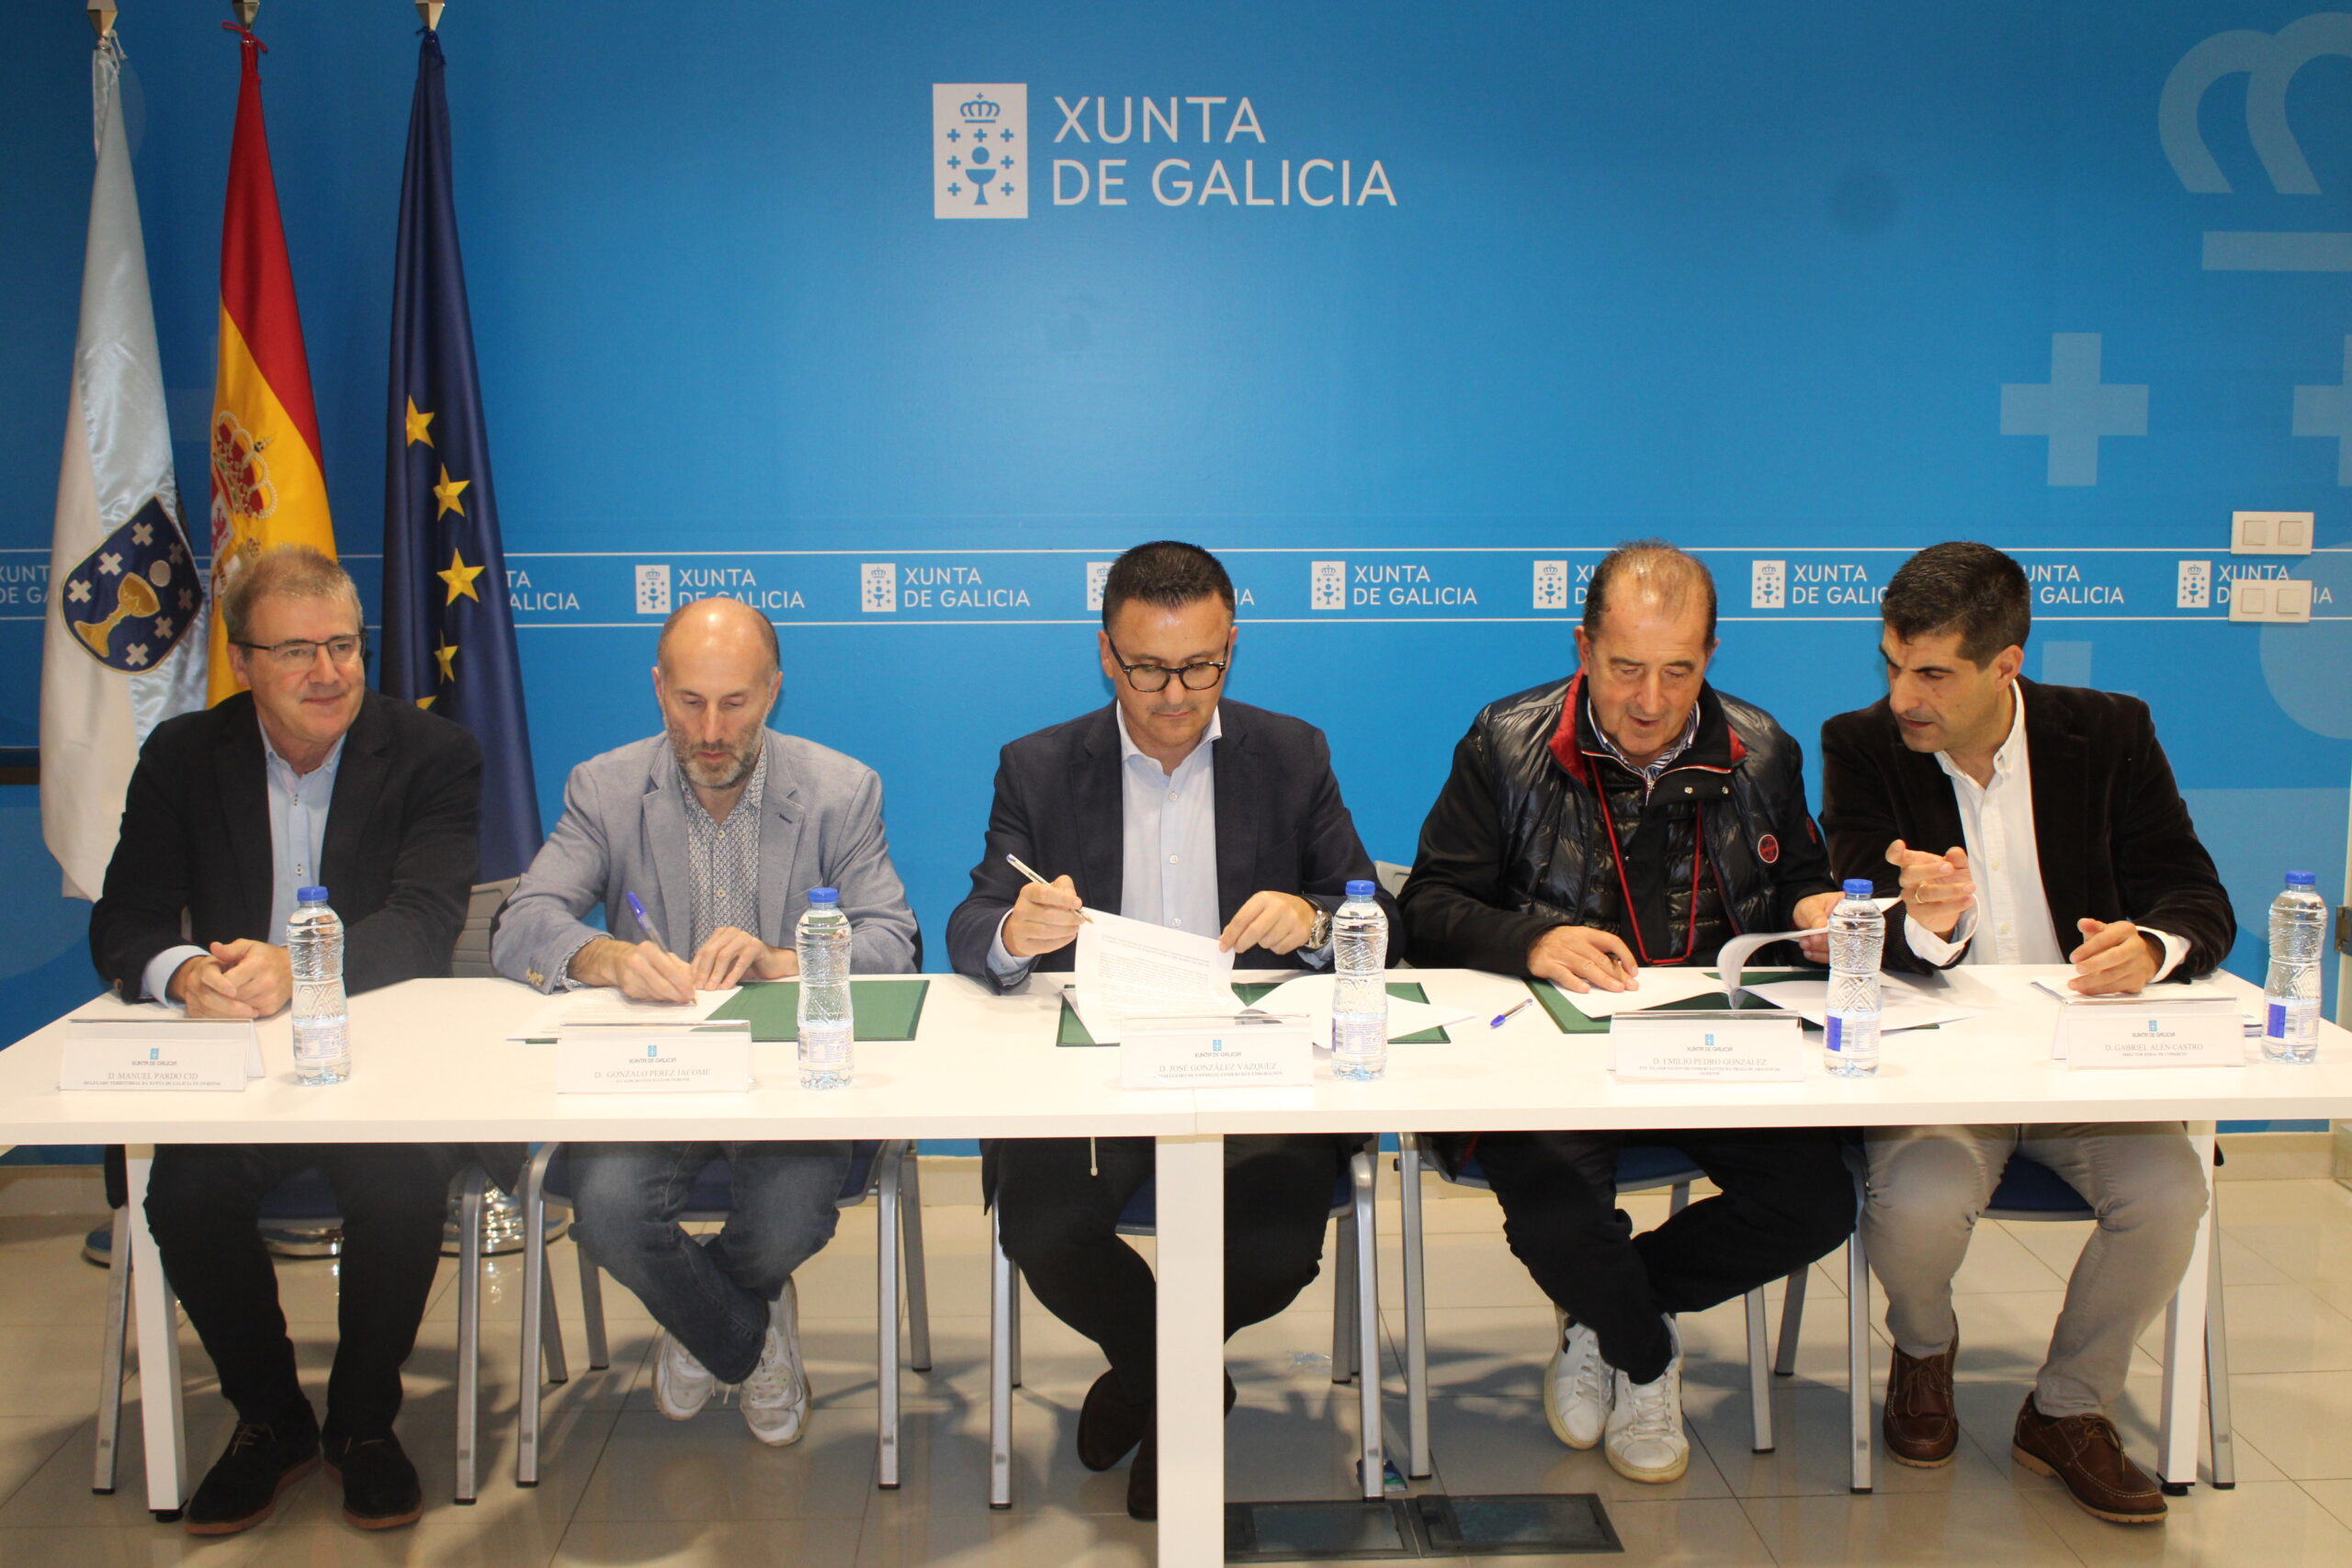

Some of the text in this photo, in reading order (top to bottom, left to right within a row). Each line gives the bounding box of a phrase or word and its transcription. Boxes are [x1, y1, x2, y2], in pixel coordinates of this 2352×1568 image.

[1053, 96, 1267, 143] XUNTA
[1053, 158, 1397, 207] DE GALICIA
[679, 569, 757, 587] XUNTA
[905, 567, 982, 585] XUNTA
[1354, 565, 1430, 582] XUNTA
[1793, 564, 1868, 582] XUNTA
[2022, 564, 2081, 582] UNTA
[2218, 565, 2290, 581] XUNTA
[510, 592, 581, 611] ALICIA
[905, 589, 1031, 608] DE GALICIA
[1353, 587, 1478, 605] DE GALICIA
[1792, 586, 1889, 604] DE GALIC
[2040, 586, 2125, 604] GALICIA
[2172, 1043, 2204, 1051] CASTRO
[1663, 1057, 1692, 1066] EMILIO
[1693, 1057, 1722, 1066] PEDRO
[154, 1072, 183, 1080] PARDO
[184, 1072, 198, 1080] CID
[606, 1069, 648, 1078] GONZALO
